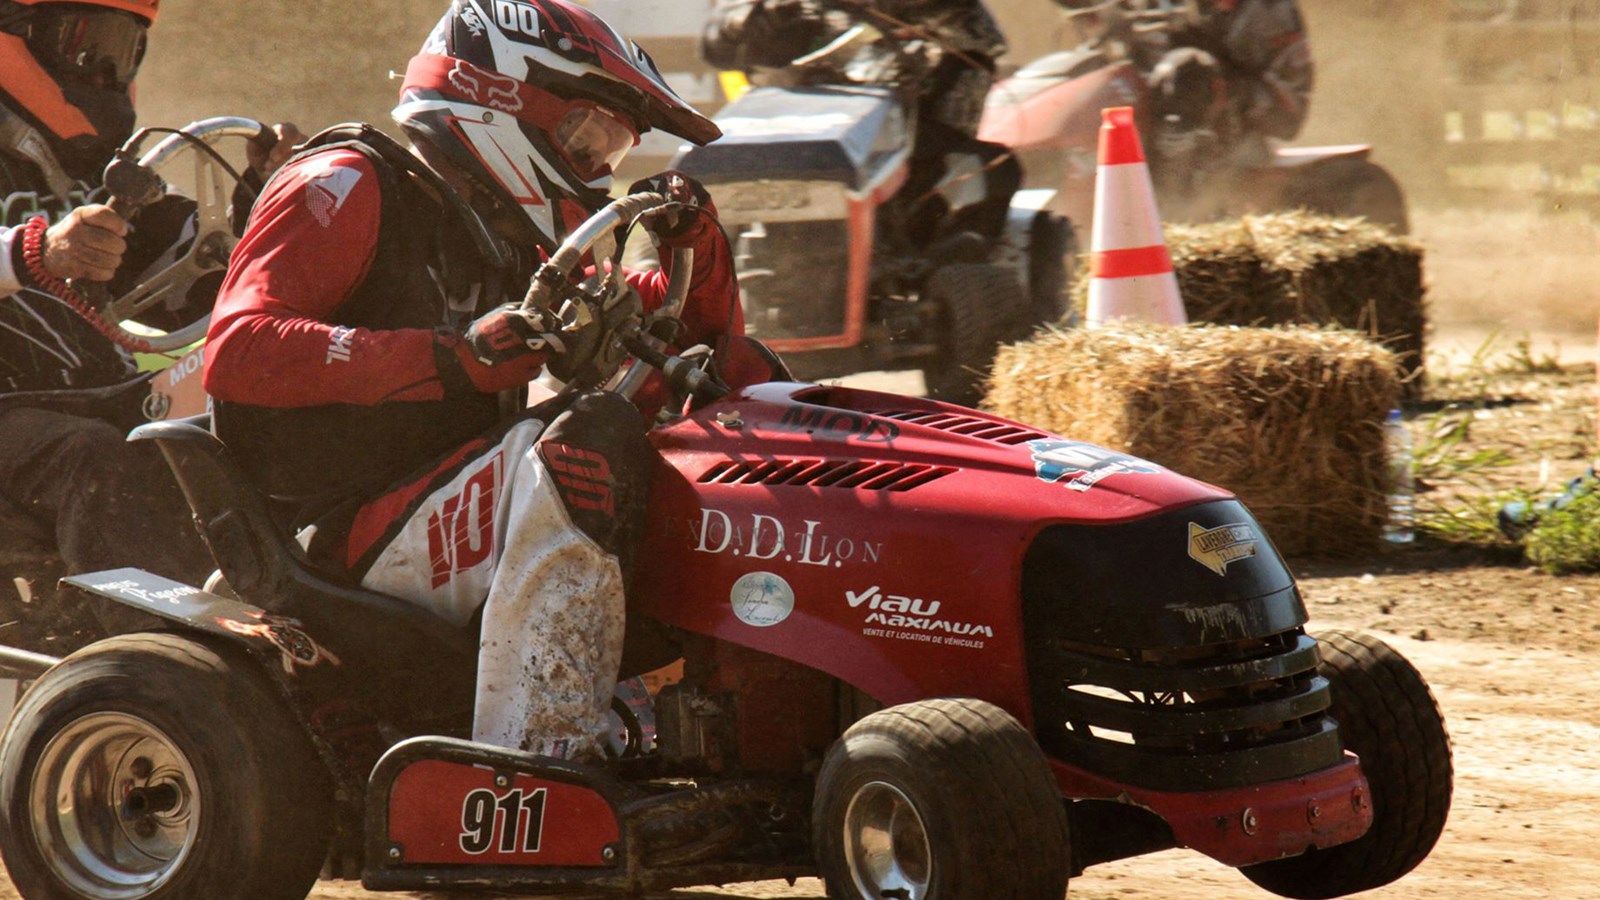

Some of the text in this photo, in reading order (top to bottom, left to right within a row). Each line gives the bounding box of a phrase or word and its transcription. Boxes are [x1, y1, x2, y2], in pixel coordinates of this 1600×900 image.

[778, 404, 900, 443] MOD
[694, 507, 843, 568] D.D.L.
[862, 628, 885, 638] VENTE
[885, 630, 895, 639] ET
[896, 631, 931, 643] LOCATION
[932, 636, 942, 644] DE
[459, 787, 548, 855] 911
